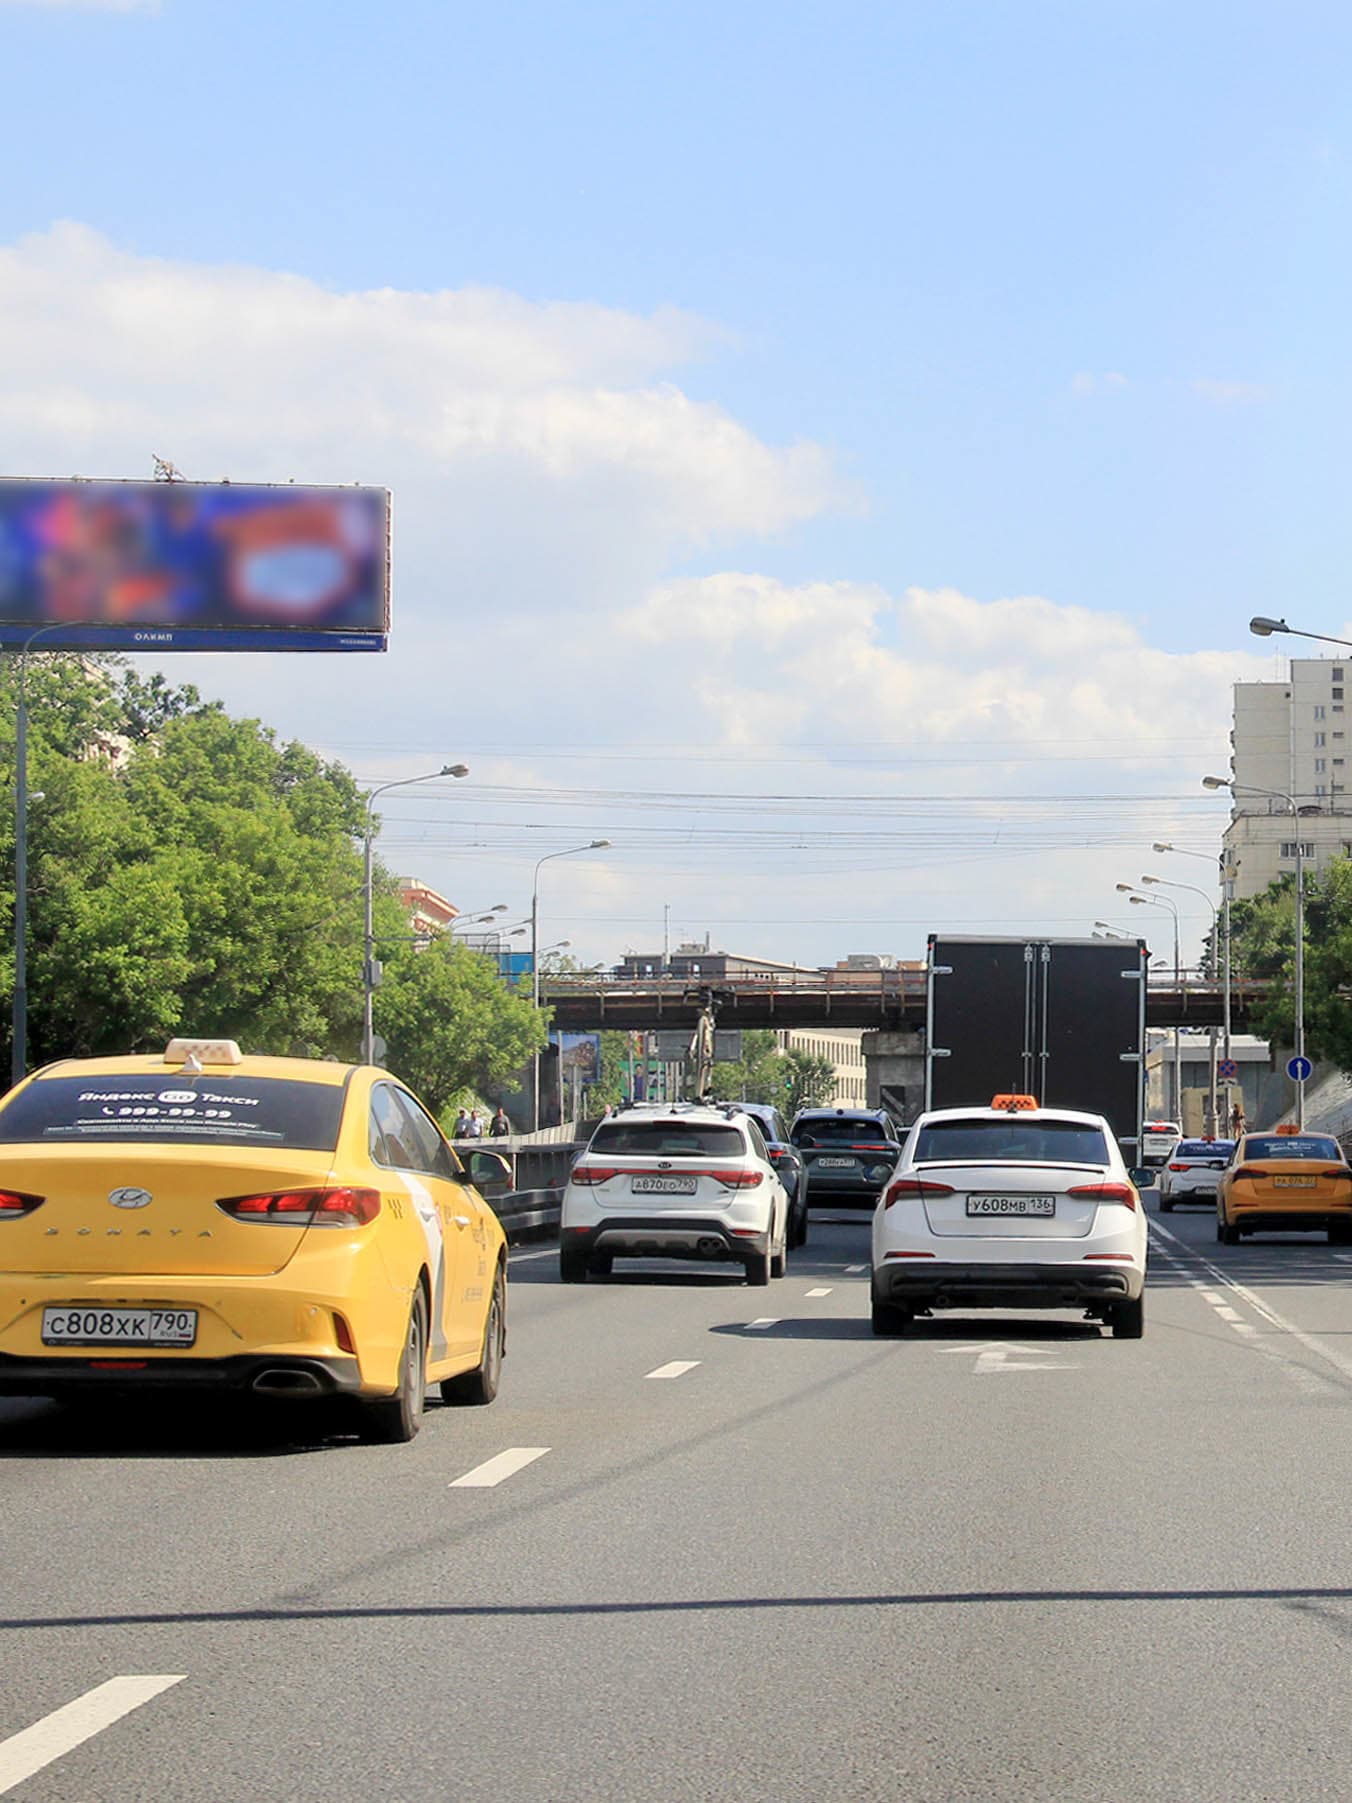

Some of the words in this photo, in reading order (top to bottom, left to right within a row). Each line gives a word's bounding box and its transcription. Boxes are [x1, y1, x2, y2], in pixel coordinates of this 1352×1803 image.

[78, 1092, 155, 1102] Яндекс
[201, 1093, 260, 1106] Такси
[118, 1107, 232, 1119] 999-99-99
[1031, 1199, 1051, 1209] 136
[45, 1227, 213, 1238] SONATA
[50, 1312, 146, 1336] С808ХК
[152, 1313, 188, 1330] 790
